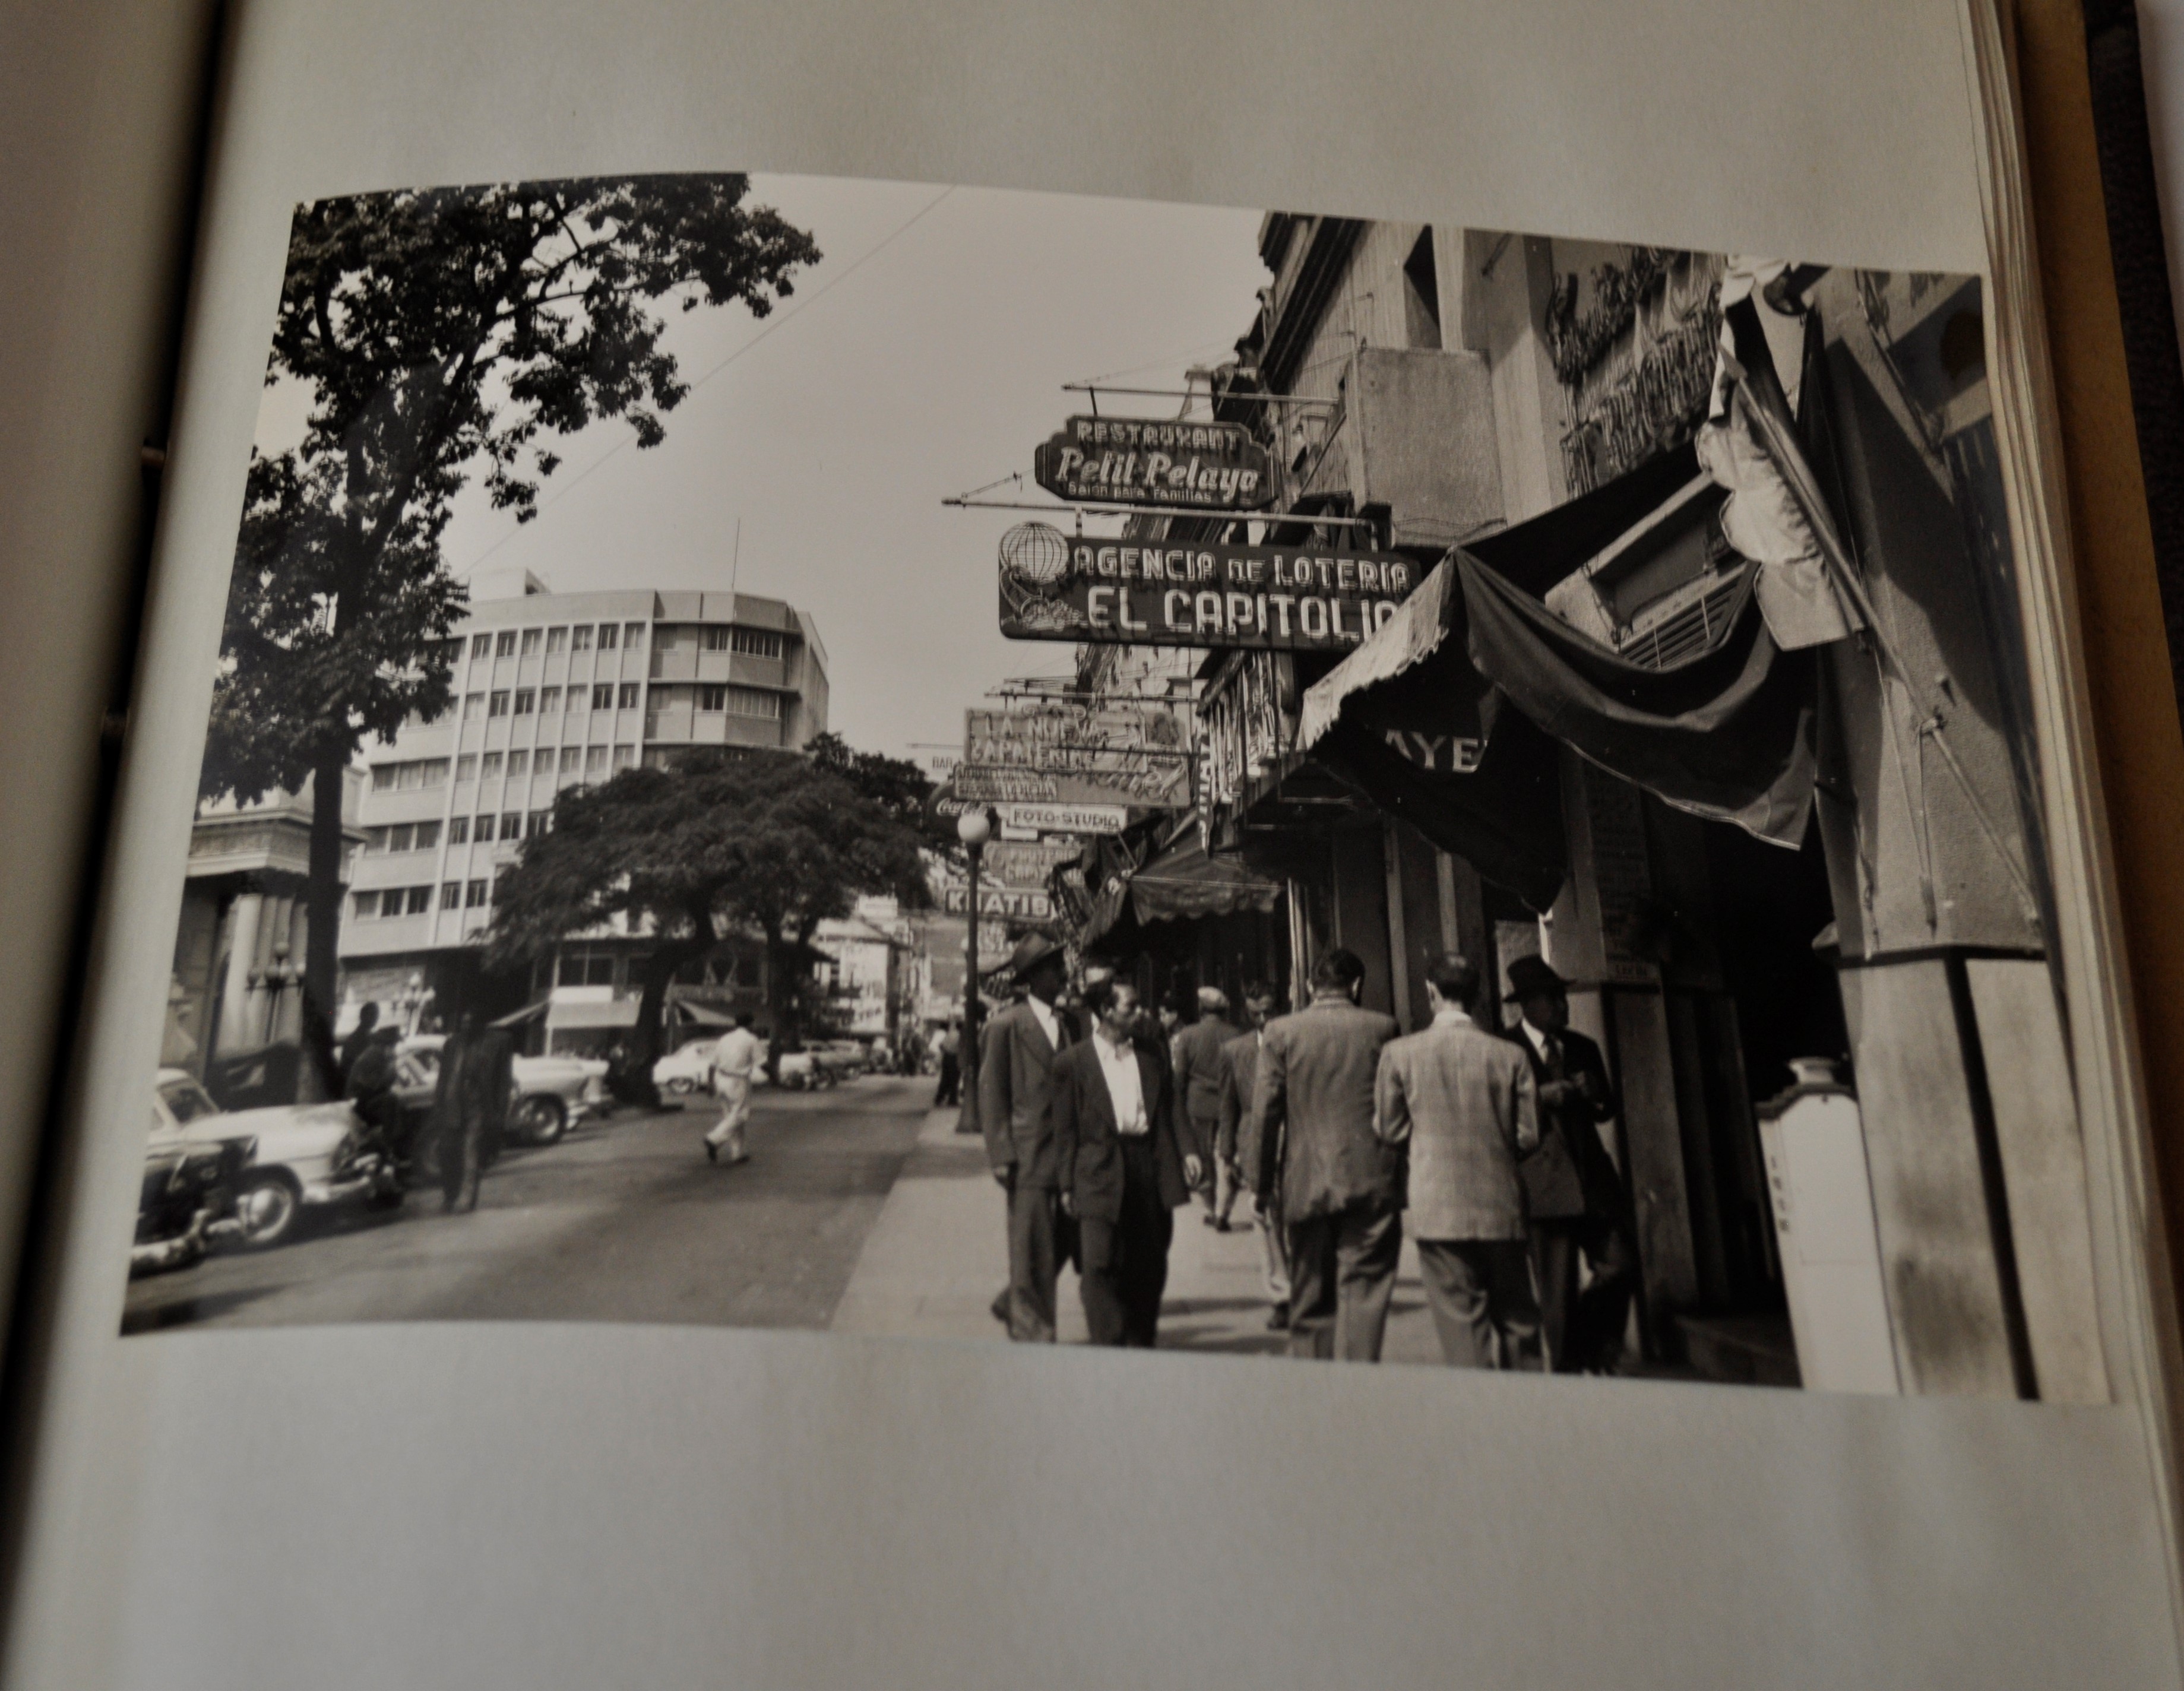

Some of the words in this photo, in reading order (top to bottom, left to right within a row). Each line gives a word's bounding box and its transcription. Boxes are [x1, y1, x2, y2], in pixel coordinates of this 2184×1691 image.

[1077, 420, 1240, 450] RESTAURANT
[1055, 446, 1137, 485] Petit
[1144, 451, 1259, 504] Pelayo
[1114, 486, 1145, 500] para
[1074, 545, 1217, 582] AGENCIA
[1227, 558, 1265, 584] DE
[1274, 555, 1410, 593] LOTERIA
[1088, 585, 1147, 631] EL
